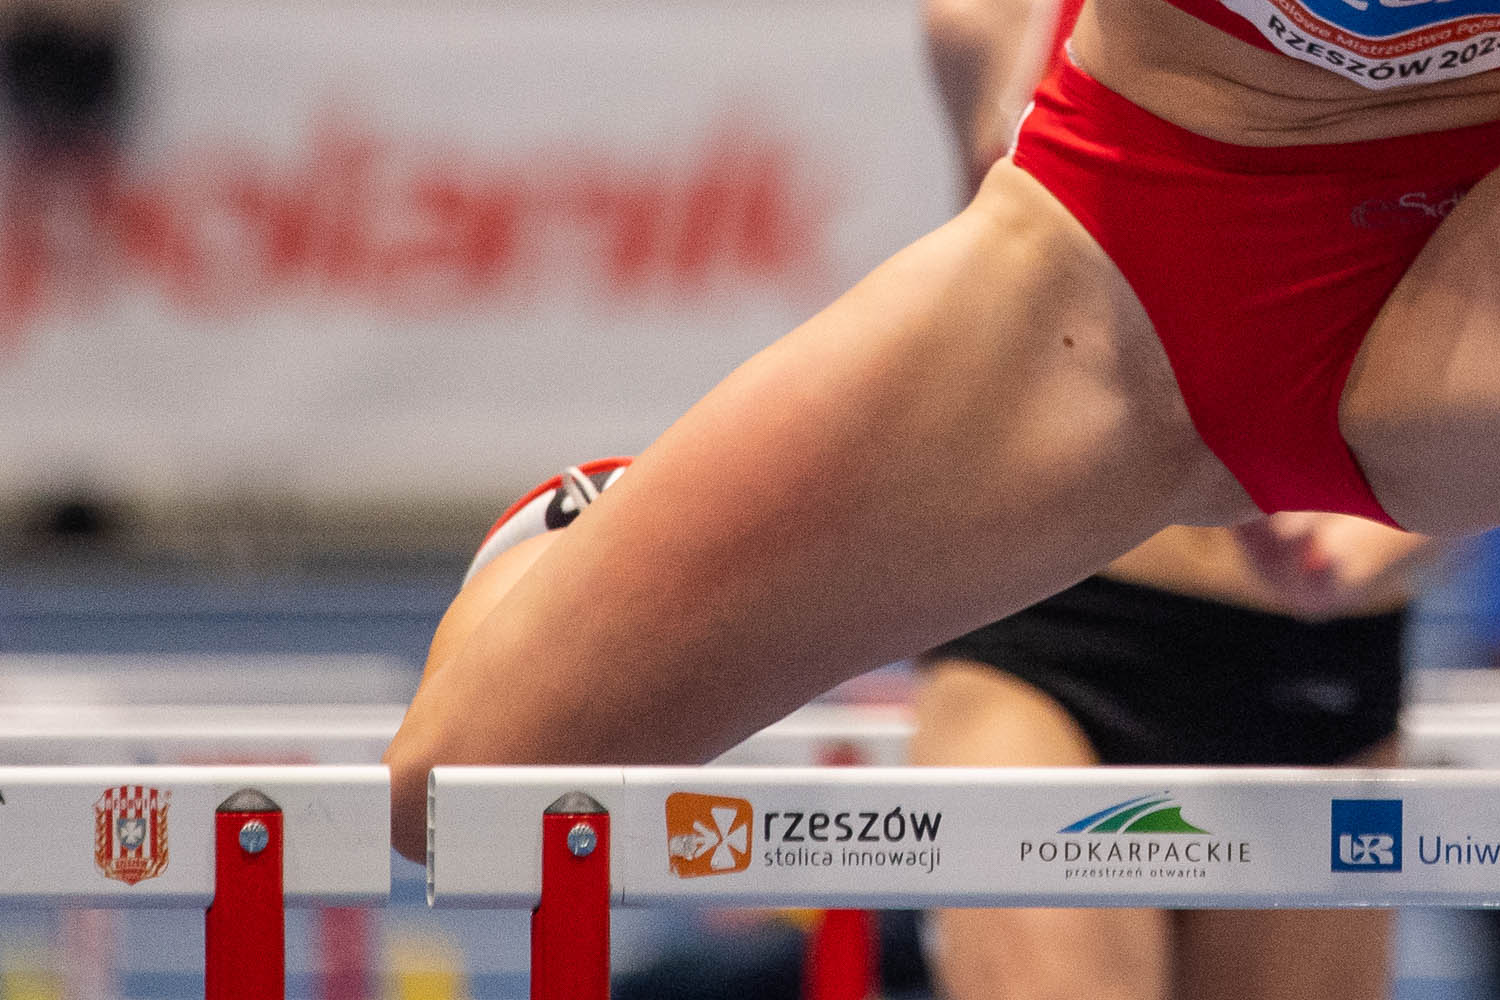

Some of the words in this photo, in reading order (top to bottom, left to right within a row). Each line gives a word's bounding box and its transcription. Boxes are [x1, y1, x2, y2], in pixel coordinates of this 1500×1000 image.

[1267, 14, 1433, 81] RZESZÓW
[1335, 28, 1453, 62] Mistrzostwa
[764, 806, 942, 843] rzeszów
[763, 846, 833, 867] stolica
[841, 846, 941, 874] innowacji
[1020, 841, 1251, 863] PODKARPACKIE
[1065, 867, 1143, 880] przestrzeń
[1149, 868, 1206, 878] otwarta
